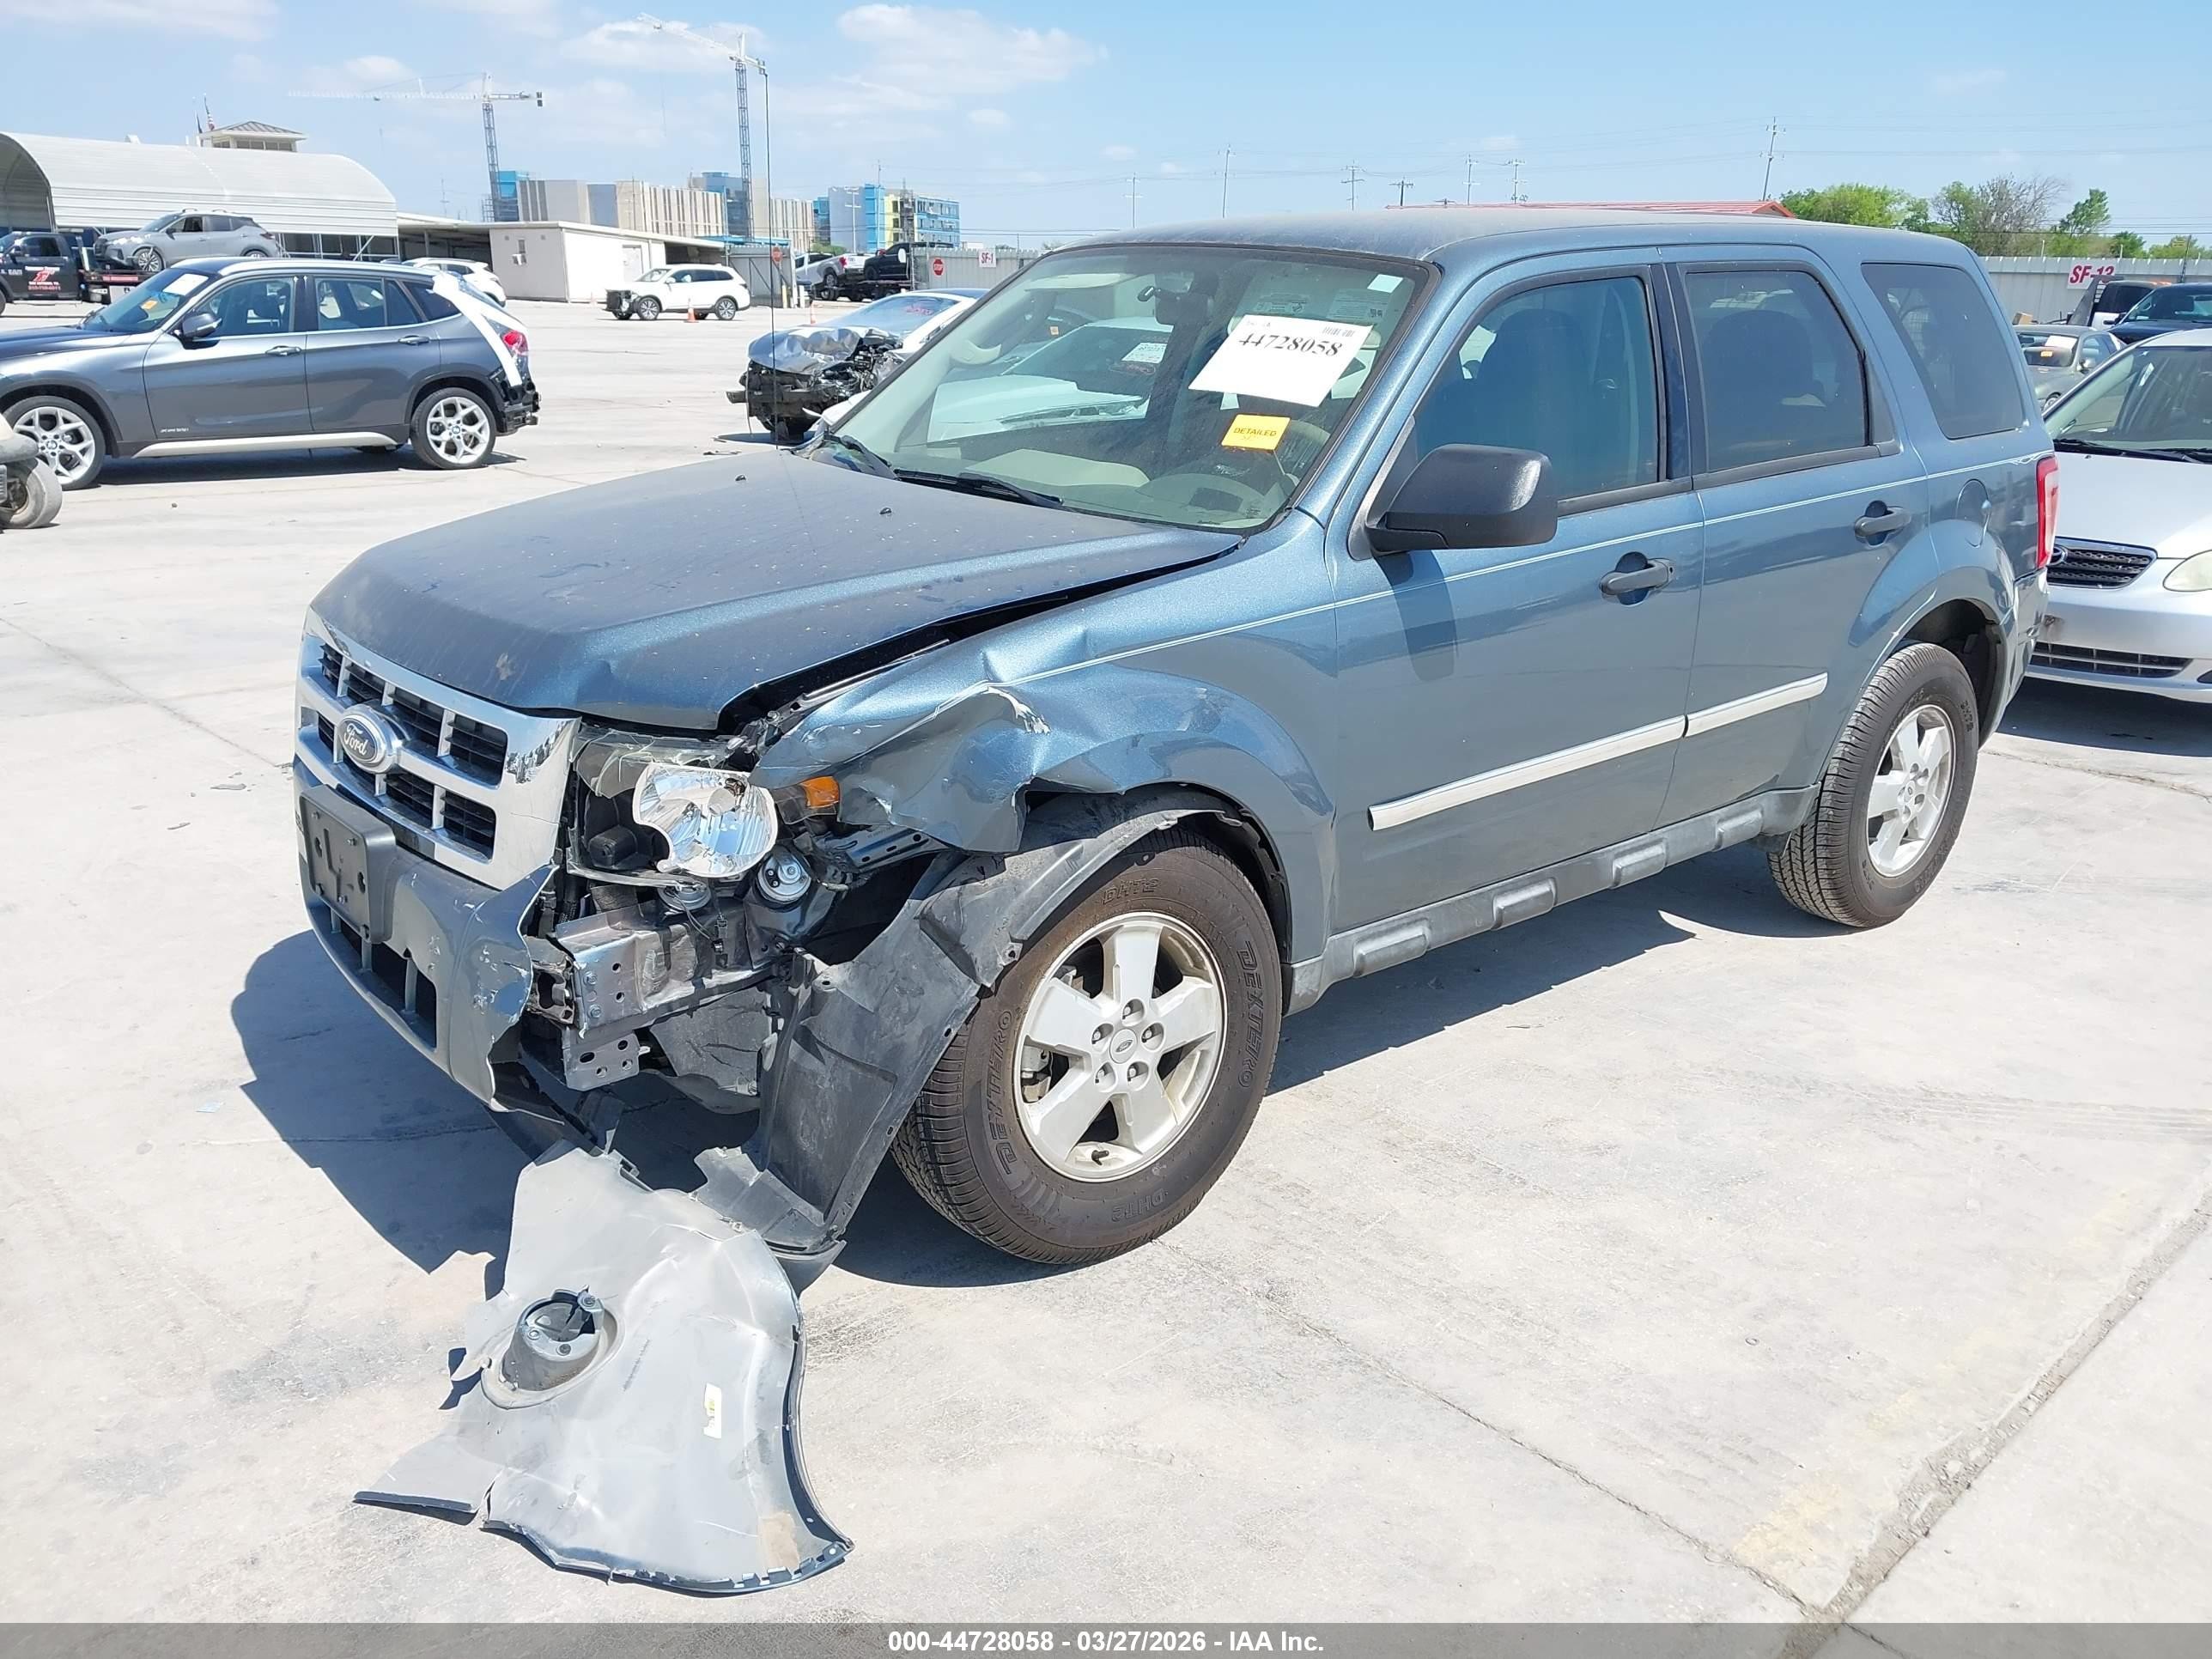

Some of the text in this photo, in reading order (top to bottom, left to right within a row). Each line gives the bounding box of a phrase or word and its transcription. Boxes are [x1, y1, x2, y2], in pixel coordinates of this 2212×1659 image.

[981, 252, 994, 264] SF-1
[1238, 332, 1343, 356] 44728058
[1233, 427, 1277, 437] DETAILED
[343, 722, 369, 756] Ford
